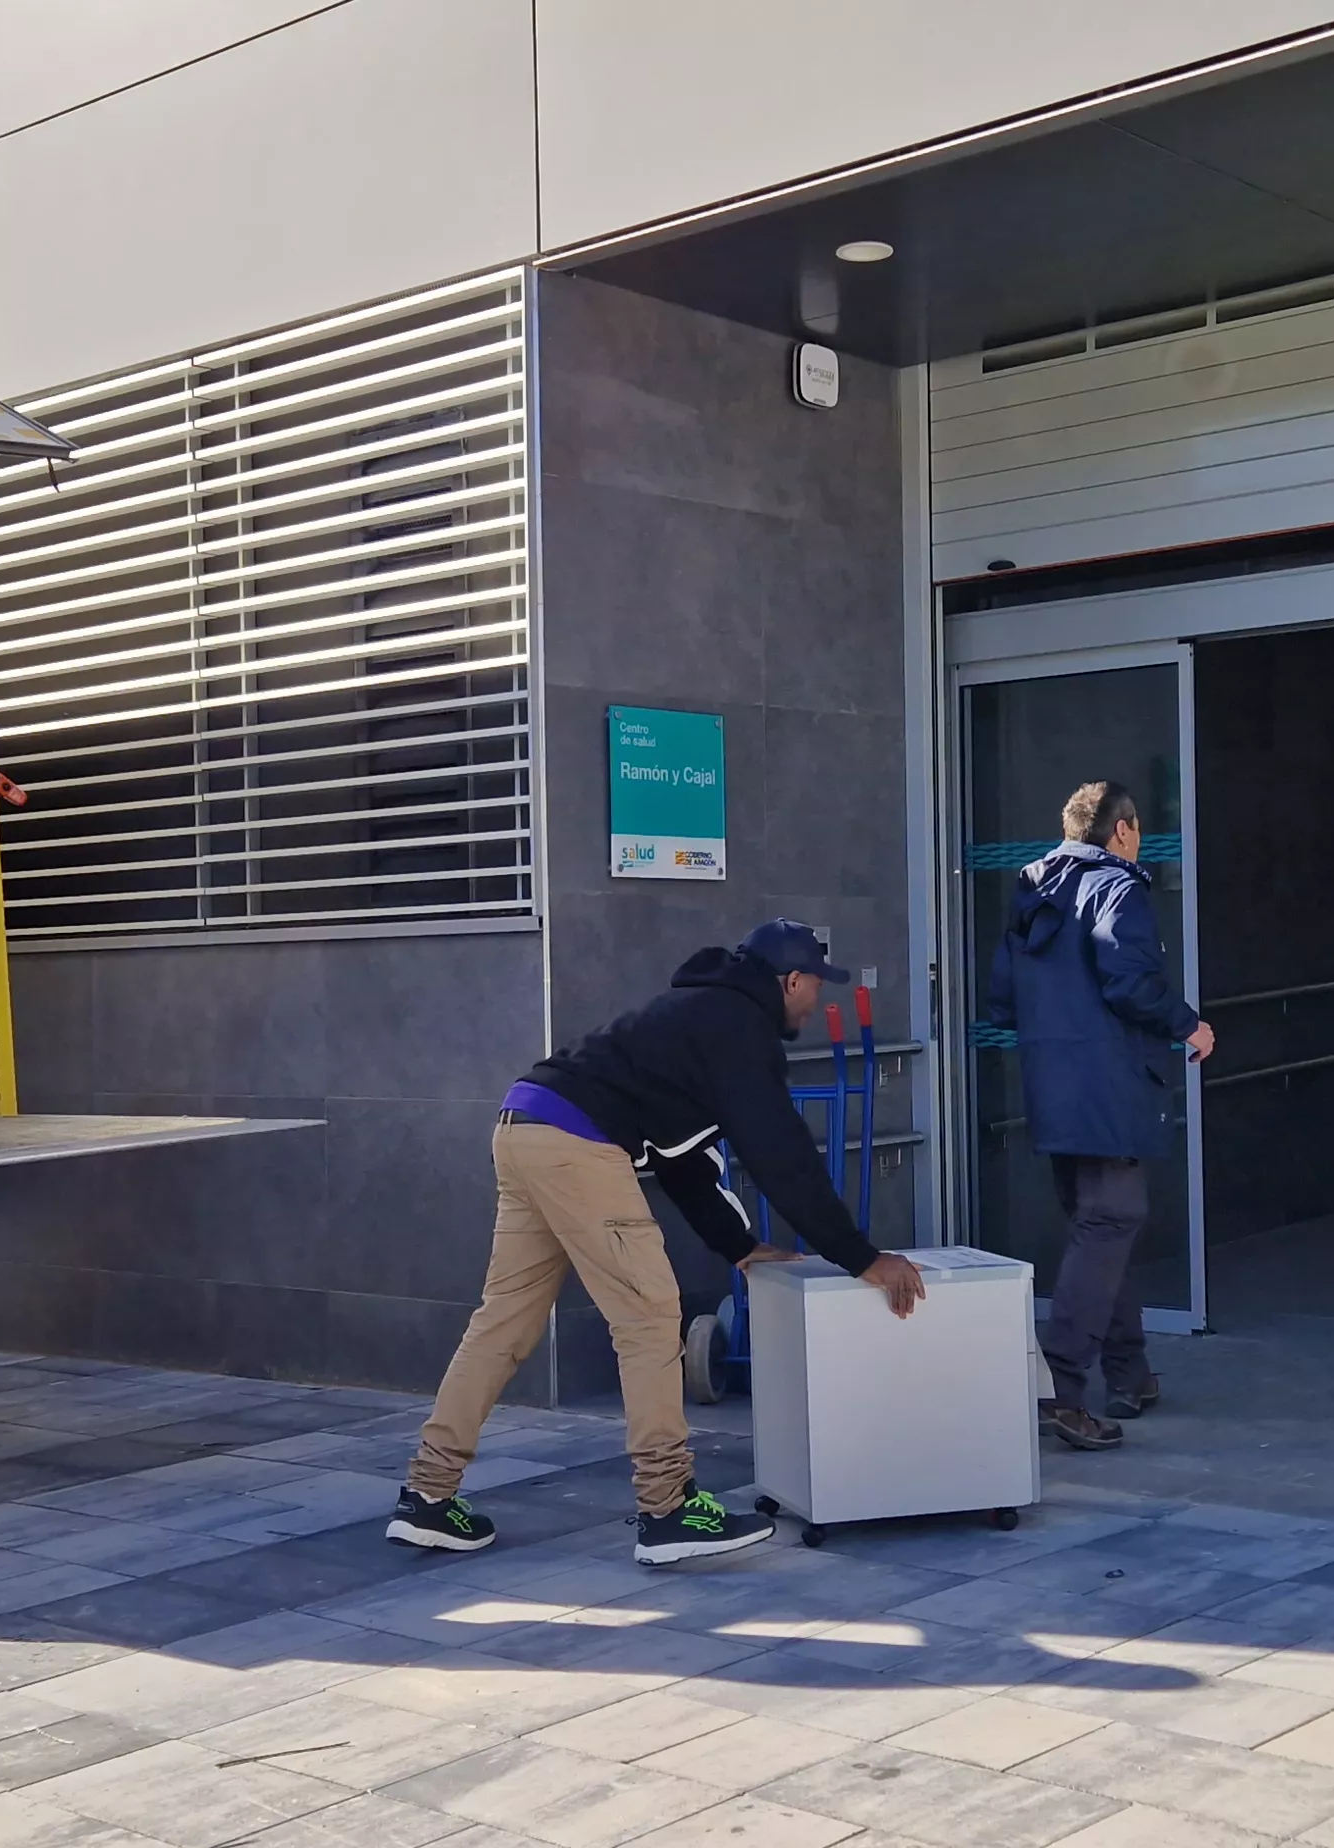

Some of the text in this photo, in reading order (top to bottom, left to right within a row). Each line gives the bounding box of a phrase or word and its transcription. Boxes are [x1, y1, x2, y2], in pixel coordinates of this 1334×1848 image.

[619, 721, 649, 735] Centro
[620, 736, 656, 748] de salud
[620, 761, 716, 787] Ramón y Cajal
[621, 843, 655, 860] salud
